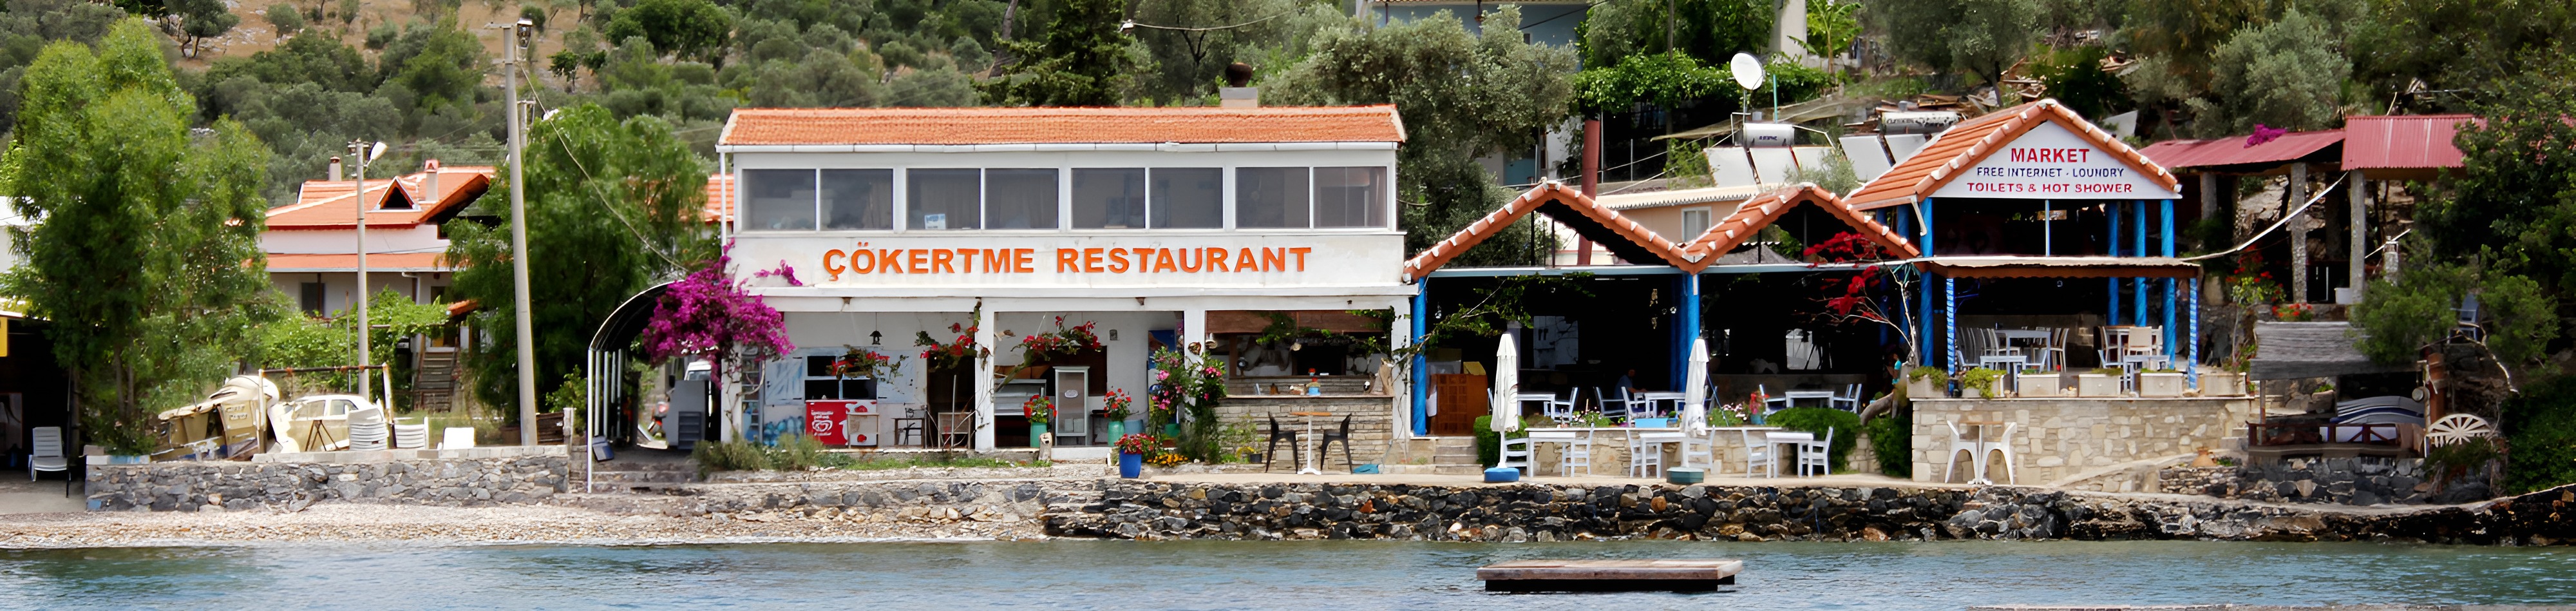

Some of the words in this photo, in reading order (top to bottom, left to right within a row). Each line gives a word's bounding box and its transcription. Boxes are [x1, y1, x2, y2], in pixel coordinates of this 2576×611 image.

[2011, 148, 2090, 163] MARKET
[1976, 167, 2004, 177] FREE
[2007, 168, 2063, 178] INTERNET
[2072, 168, 2125, 178] LOUNDRY
[1967, 182, 2023, 193] TOILETS
[2028, 184, 2037, 193] &
[2042, 184, 2070, 193] HOT
[2075, 184, 2132, 193] SHOWER
[822, 242, 1034, 282] ÇÖKERTME
[1057, 247, 1312, 273] RESTAURANT
